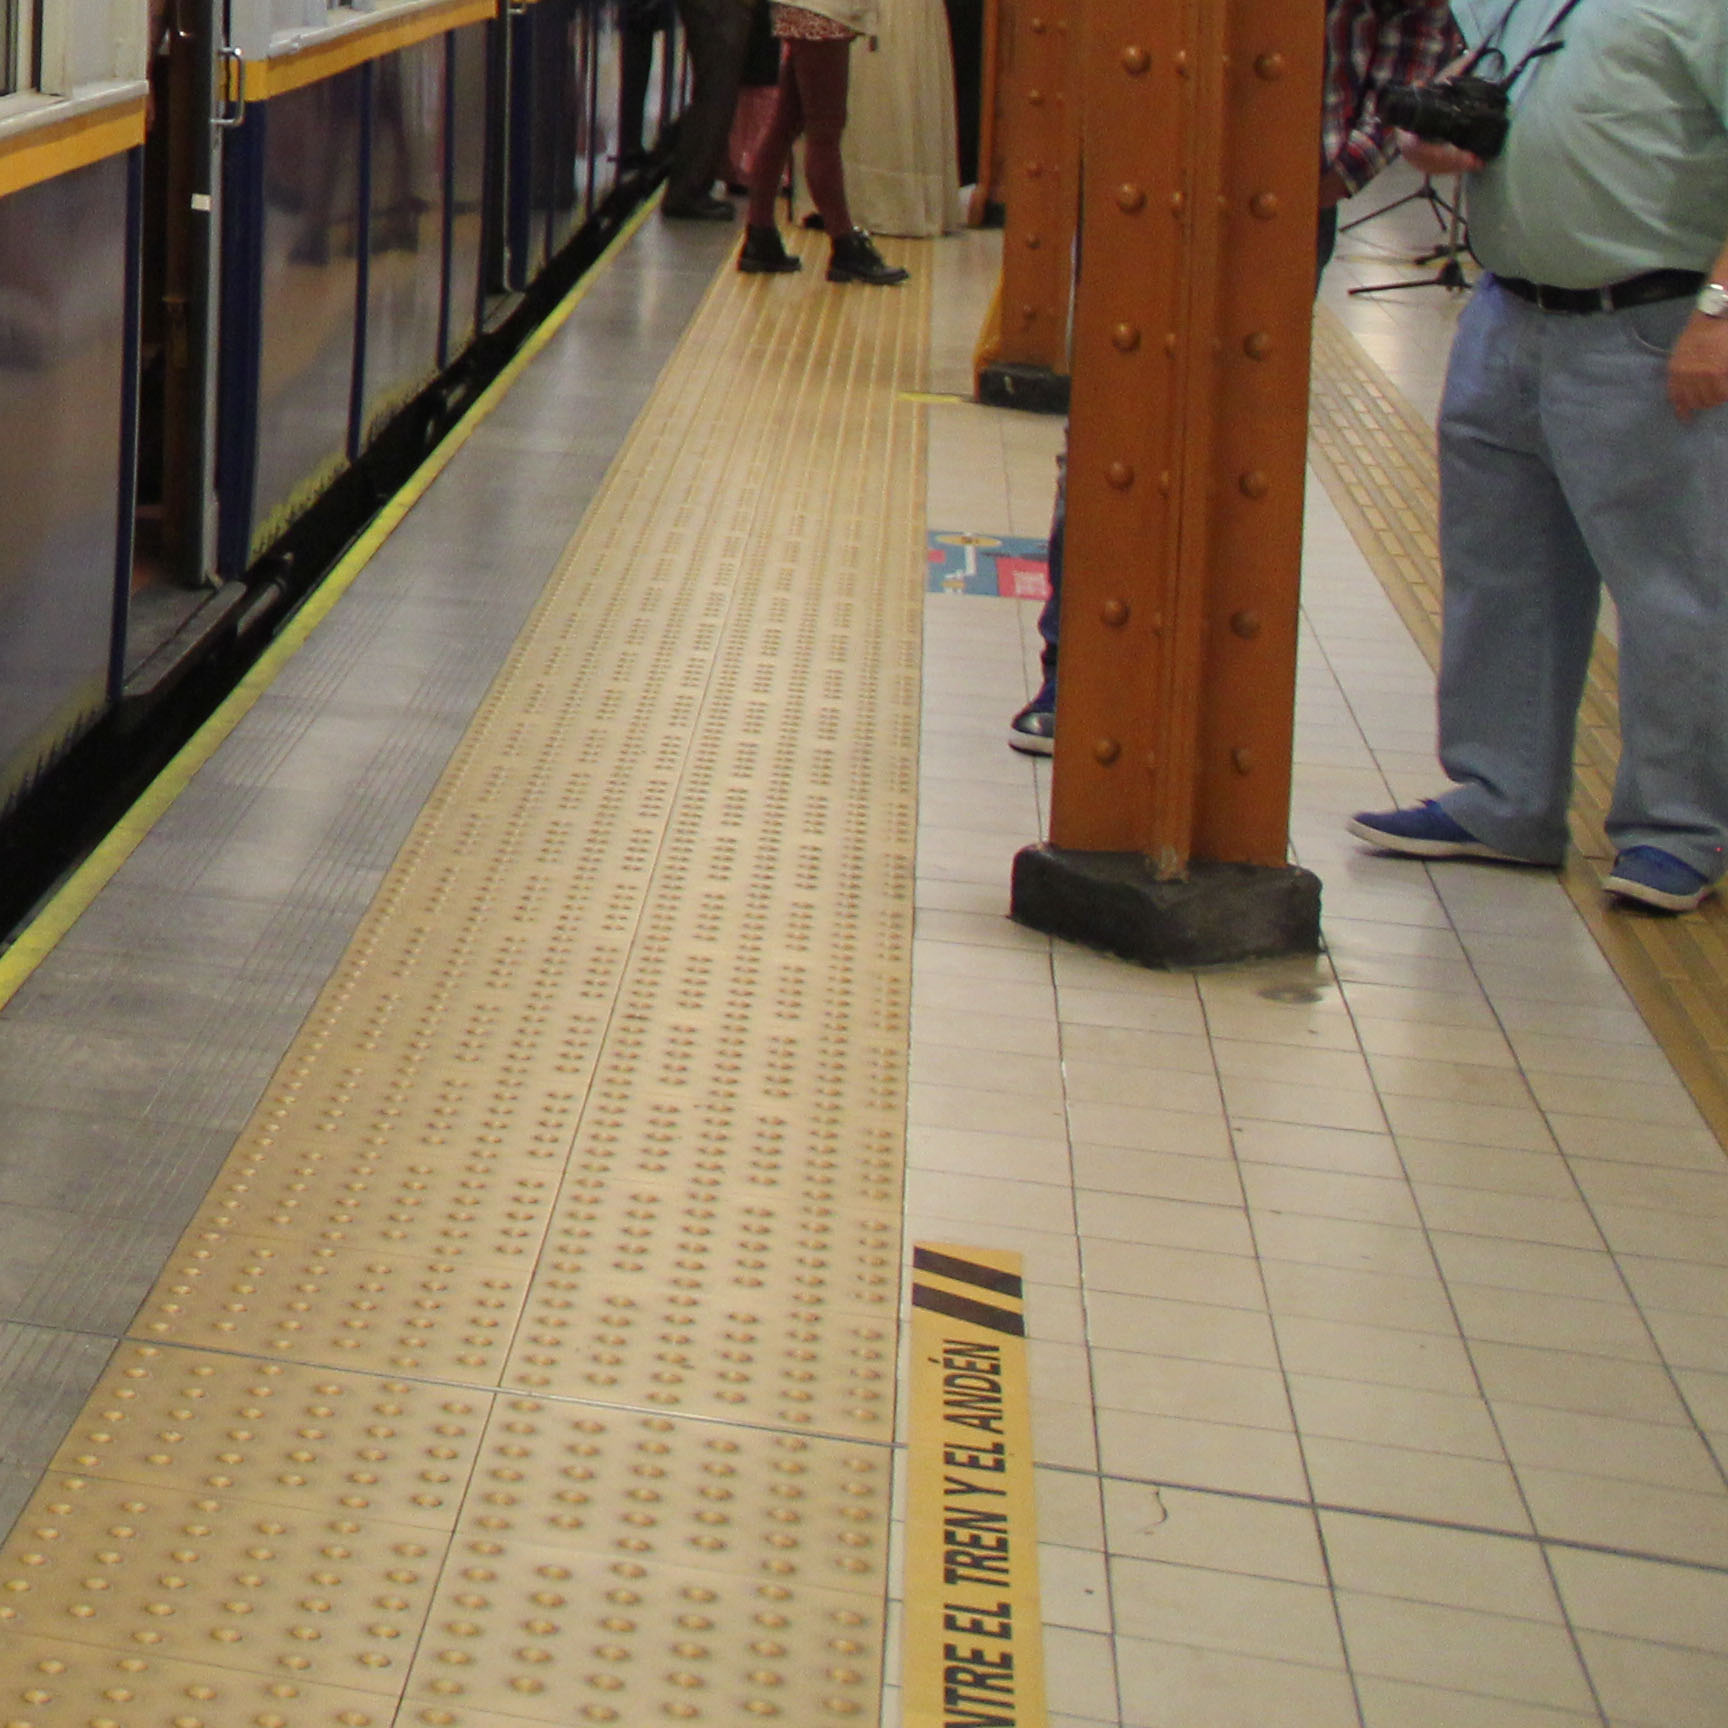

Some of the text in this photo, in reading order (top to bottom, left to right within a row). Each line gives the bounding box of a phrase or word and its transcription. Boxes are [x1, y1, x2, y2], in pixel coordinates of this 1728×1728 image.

[928, 1339, 1005, 1436] ANDÉN
[943, 1442, 1007, 1474] EL
[943, 1474, 1008, 1498] Y
[943, 1505, 1011, 1589] TREN
[943, 1601, 1013, 1640] EL
